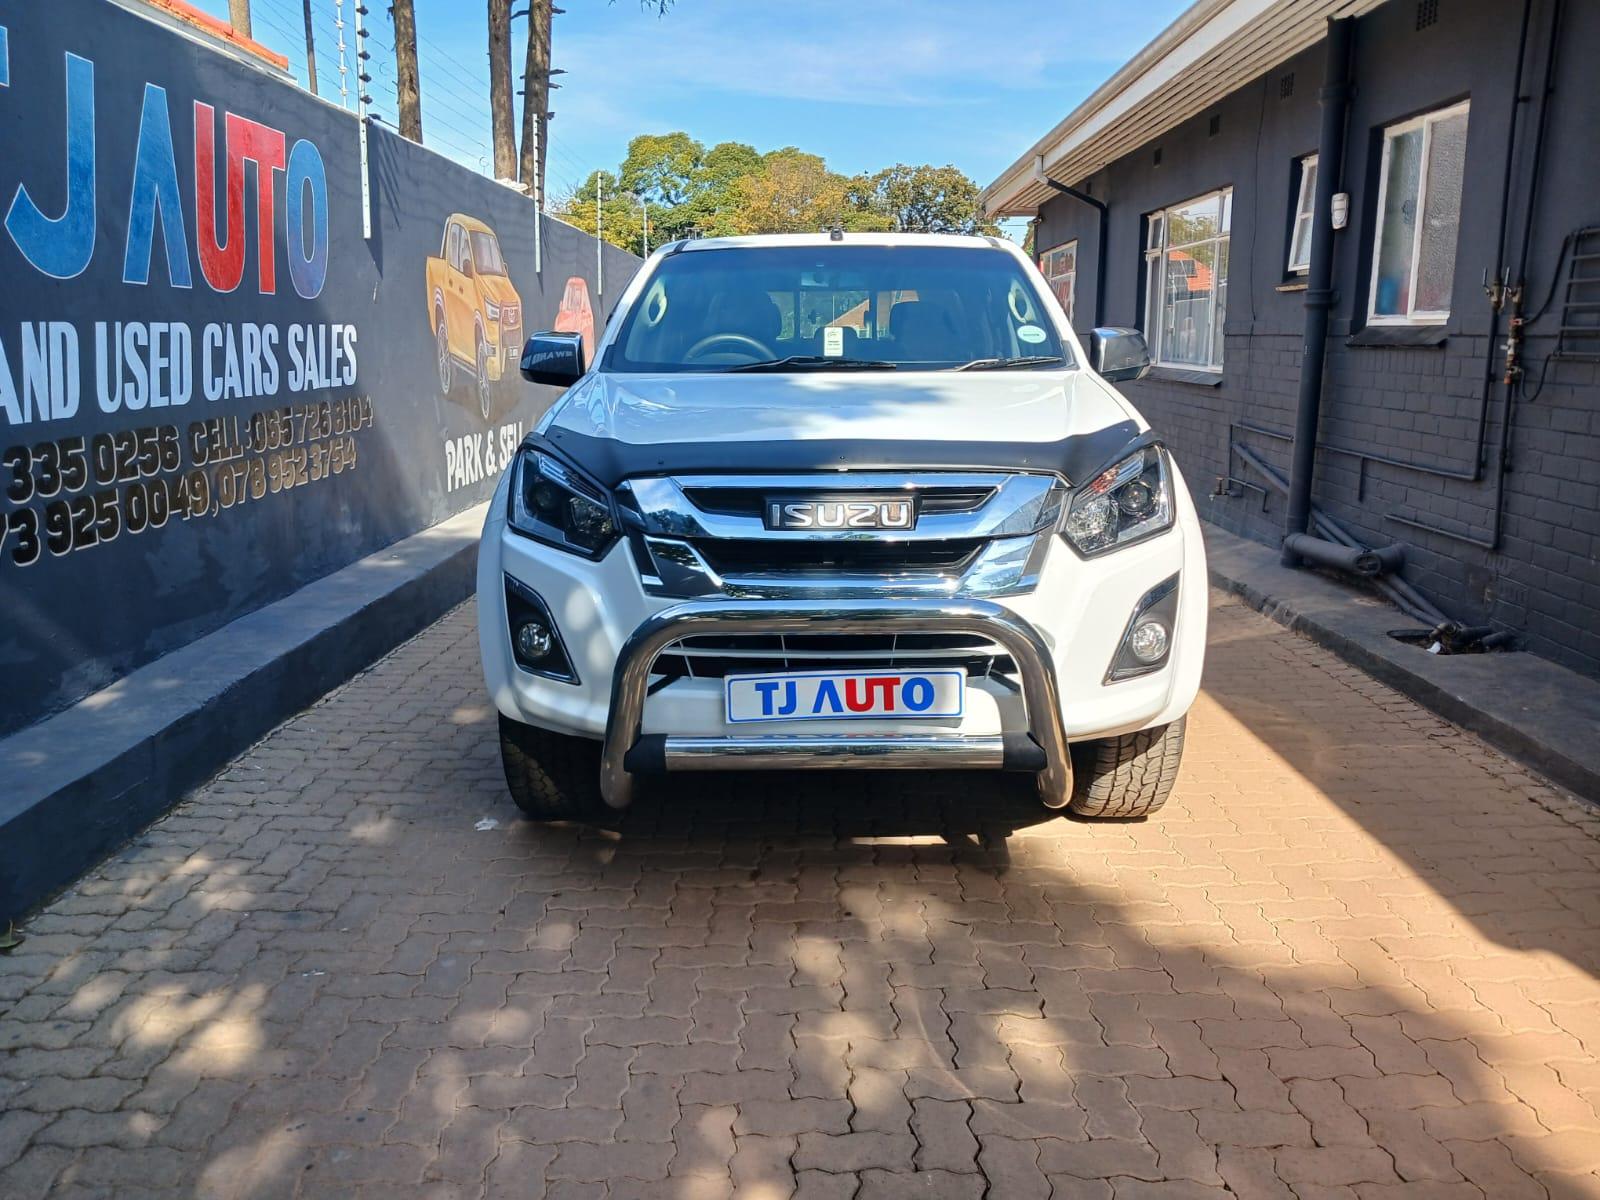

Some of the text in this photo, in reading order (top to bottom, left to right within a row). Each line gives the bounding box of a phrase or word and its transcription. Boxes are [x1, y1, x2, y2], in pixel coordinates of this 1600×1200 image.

[0, 26, 328, 300] J AUTO
[95, 321, 193, 413] USED
[202, 322, 279, 401] CARS
[288, 323, 358, 392] SALES
[3, 435, 88, 504] 335
[92, 424, 182, 486] 0256
[445, 433, 484, 492] PARK
[485, 430, 497, 477] &
[46, 488, 121, 556] 925
[771, 503, 908, 527] ISUZU
[754, 677, 935, 716] TJ AUTO
